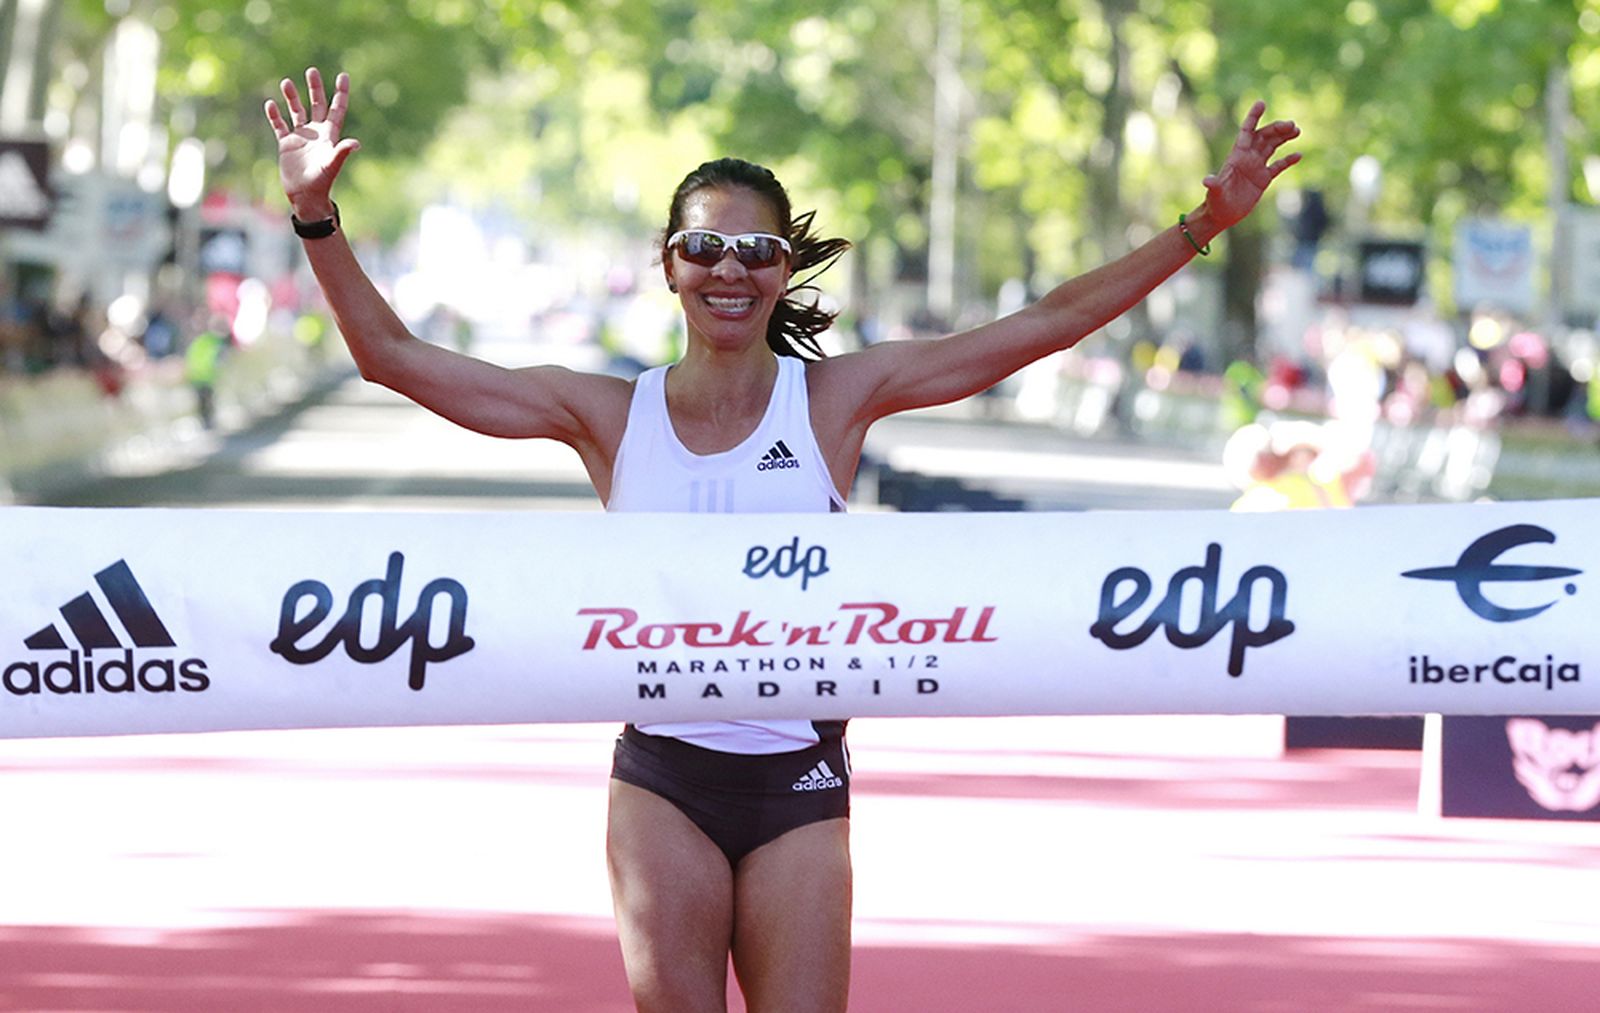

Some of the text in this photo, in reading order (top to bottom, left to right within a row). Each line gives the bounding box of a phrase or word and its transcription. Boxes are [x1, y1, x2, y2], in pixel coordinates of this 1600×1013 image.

[757, 459, 800, 472] adidas
[742, 536, 830, 591] edp
[269, 551, 475, 691] edp
[576, 608, 774, 650] Rock
[839, 602, 999, 645] Roll
[1090, 542, 1295, 677] edp
[2, 647, 210, 695] adidas
[637, 655, 939, 674] MARATHON & 1/2
[1409, 656, 1581, 690] iberCaja
[637, 678, 939, 699] MADRID
[792, 777, 842, 792] adidas
